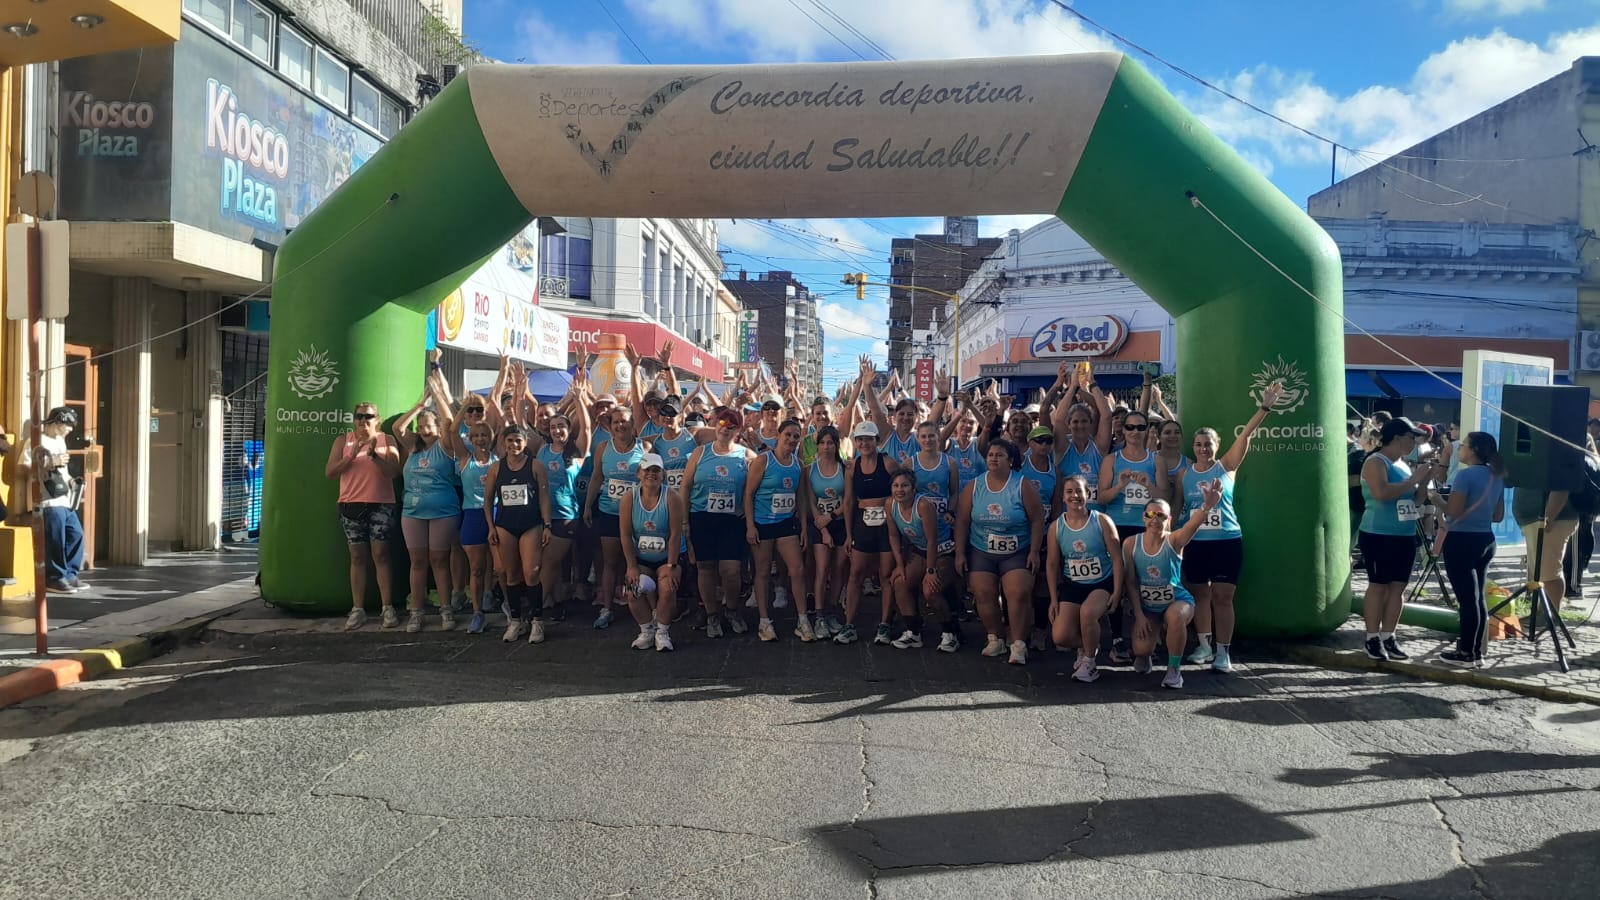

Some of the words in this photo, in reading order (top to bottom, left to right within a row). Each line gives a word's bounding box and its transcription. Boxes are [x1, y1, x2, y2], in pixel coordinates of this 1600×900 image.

[710, 80, 865, 115] Concordia
[61, 90, 154, 129] Kiosco
[552, 97, 643, 125] Deportes
[206, 79, 288, 178] Kiosco
[78, 127, 138, 157] Plaza
[709, 139, 815, 170] ciudad
[826, 131, 1031, 173] Saludable!!
[223, 157, 277, 224] Plaza
[1061, 321, 1109, 343] Red
[749, 327, 757, 362] mayo
[1061, 342, 1109, 352] SPORT
[276, 407, 354, 424] Concordia
[276, 425, 354, 435] MUNICIPALIDAD
[502, 489, 526, 500] 634
[1126, 488, 1151, 499] 563
[709, 498, 734, 510] 734
[773, 497, 794, 508] 510
[863, 510, 887, 520] 521
[640, 541, 664, 551] 647
[988, 539, 1017, 552] 183
[1070, 562, 1101, 577] 105
[1141, 588, 1174, 602] 225
